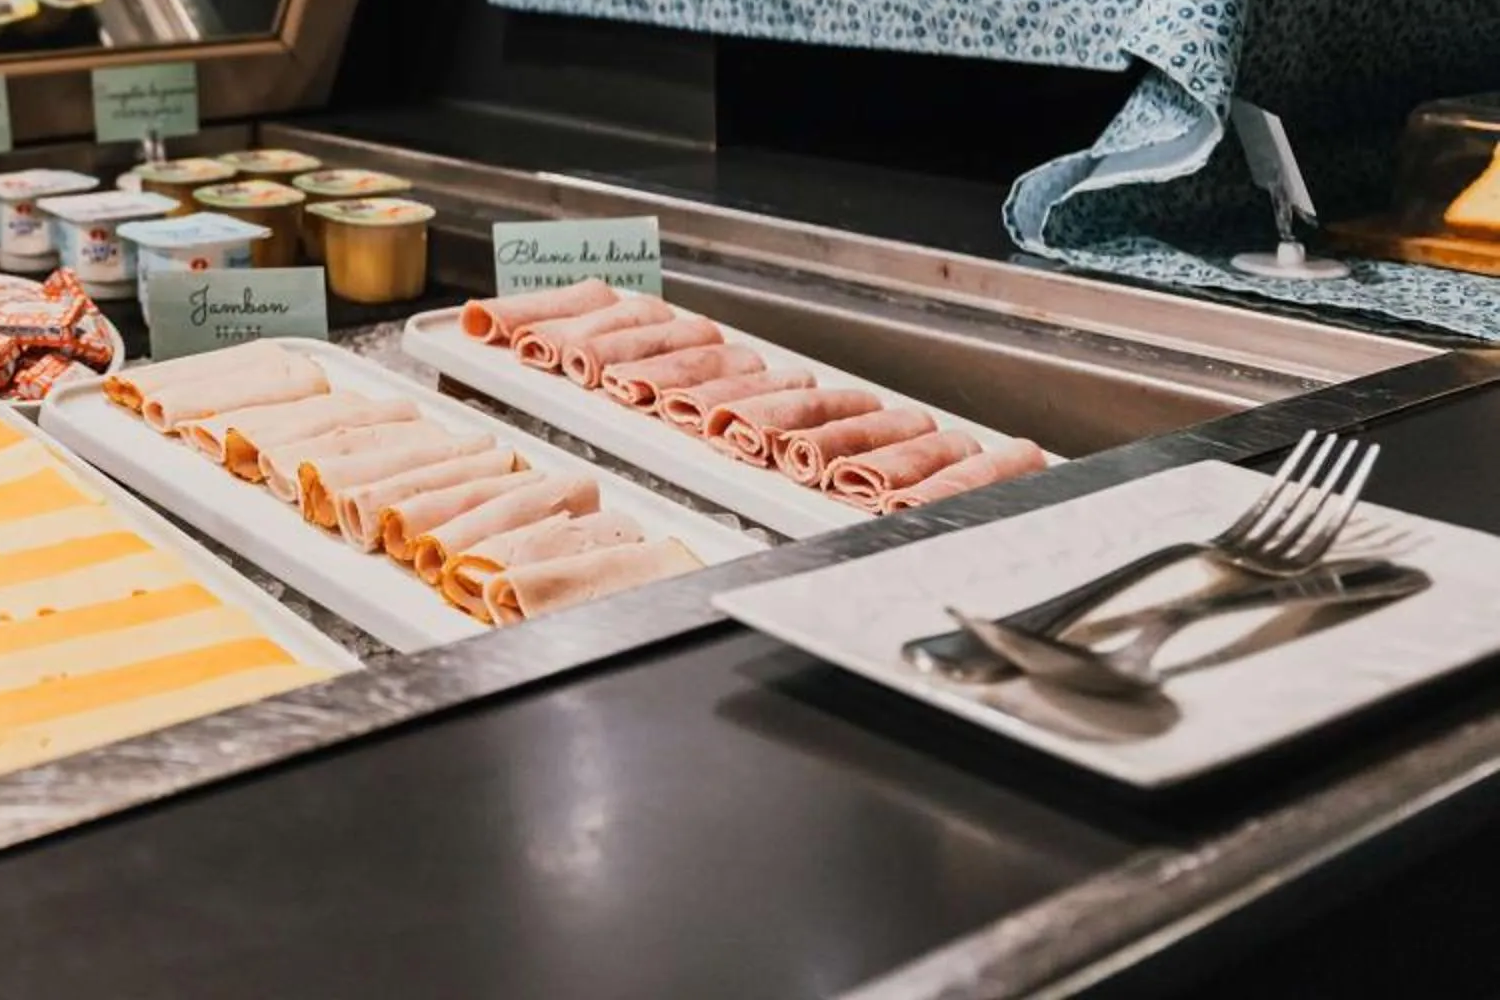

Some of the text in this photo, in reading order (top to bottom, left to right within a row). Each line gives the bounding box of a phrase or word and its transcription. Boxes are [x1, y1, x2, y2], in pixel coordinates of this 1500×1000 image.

[498, 238, 661, 266] Blanc de dinde
[581, 272, 645, 287] EAST
[189, 284, 291, 326] Jambon
